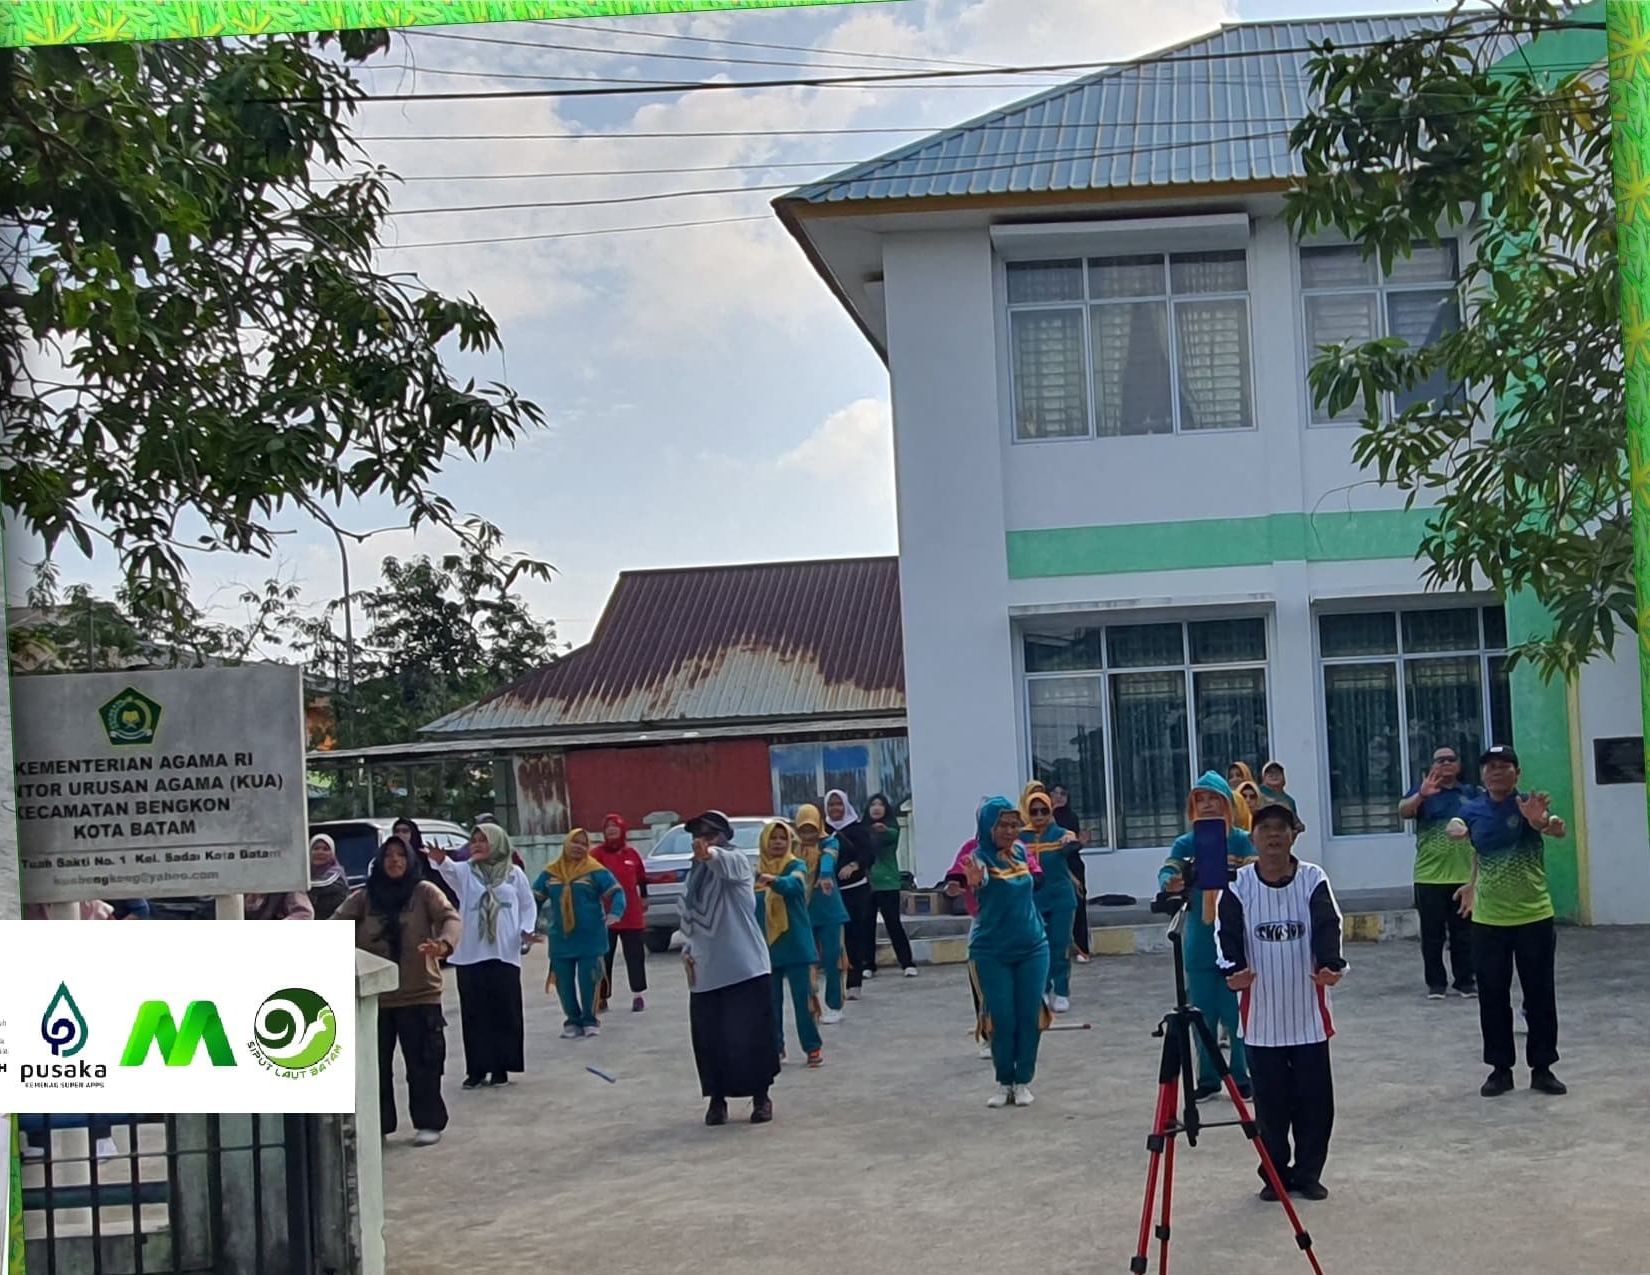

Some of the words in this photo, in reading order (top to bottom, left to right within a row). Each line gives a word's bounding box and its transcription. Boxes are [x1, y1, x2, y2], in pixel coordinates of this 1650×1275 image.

[16, 756, 153, 776] KEMENTERIAN
[160, 753, 228, 769] AGAMA
[235, 752, 253, 766] RI
[69, 779, 148, 795] URUSAN
[155, 776, 224, 792] AGAMA
[230, 773, 283, 792] (KUA)
[135, 797, 230, 815] BENGKON
[73, 823, 124, 840] KOTA
[131, 820, 196, 836] BATAM
